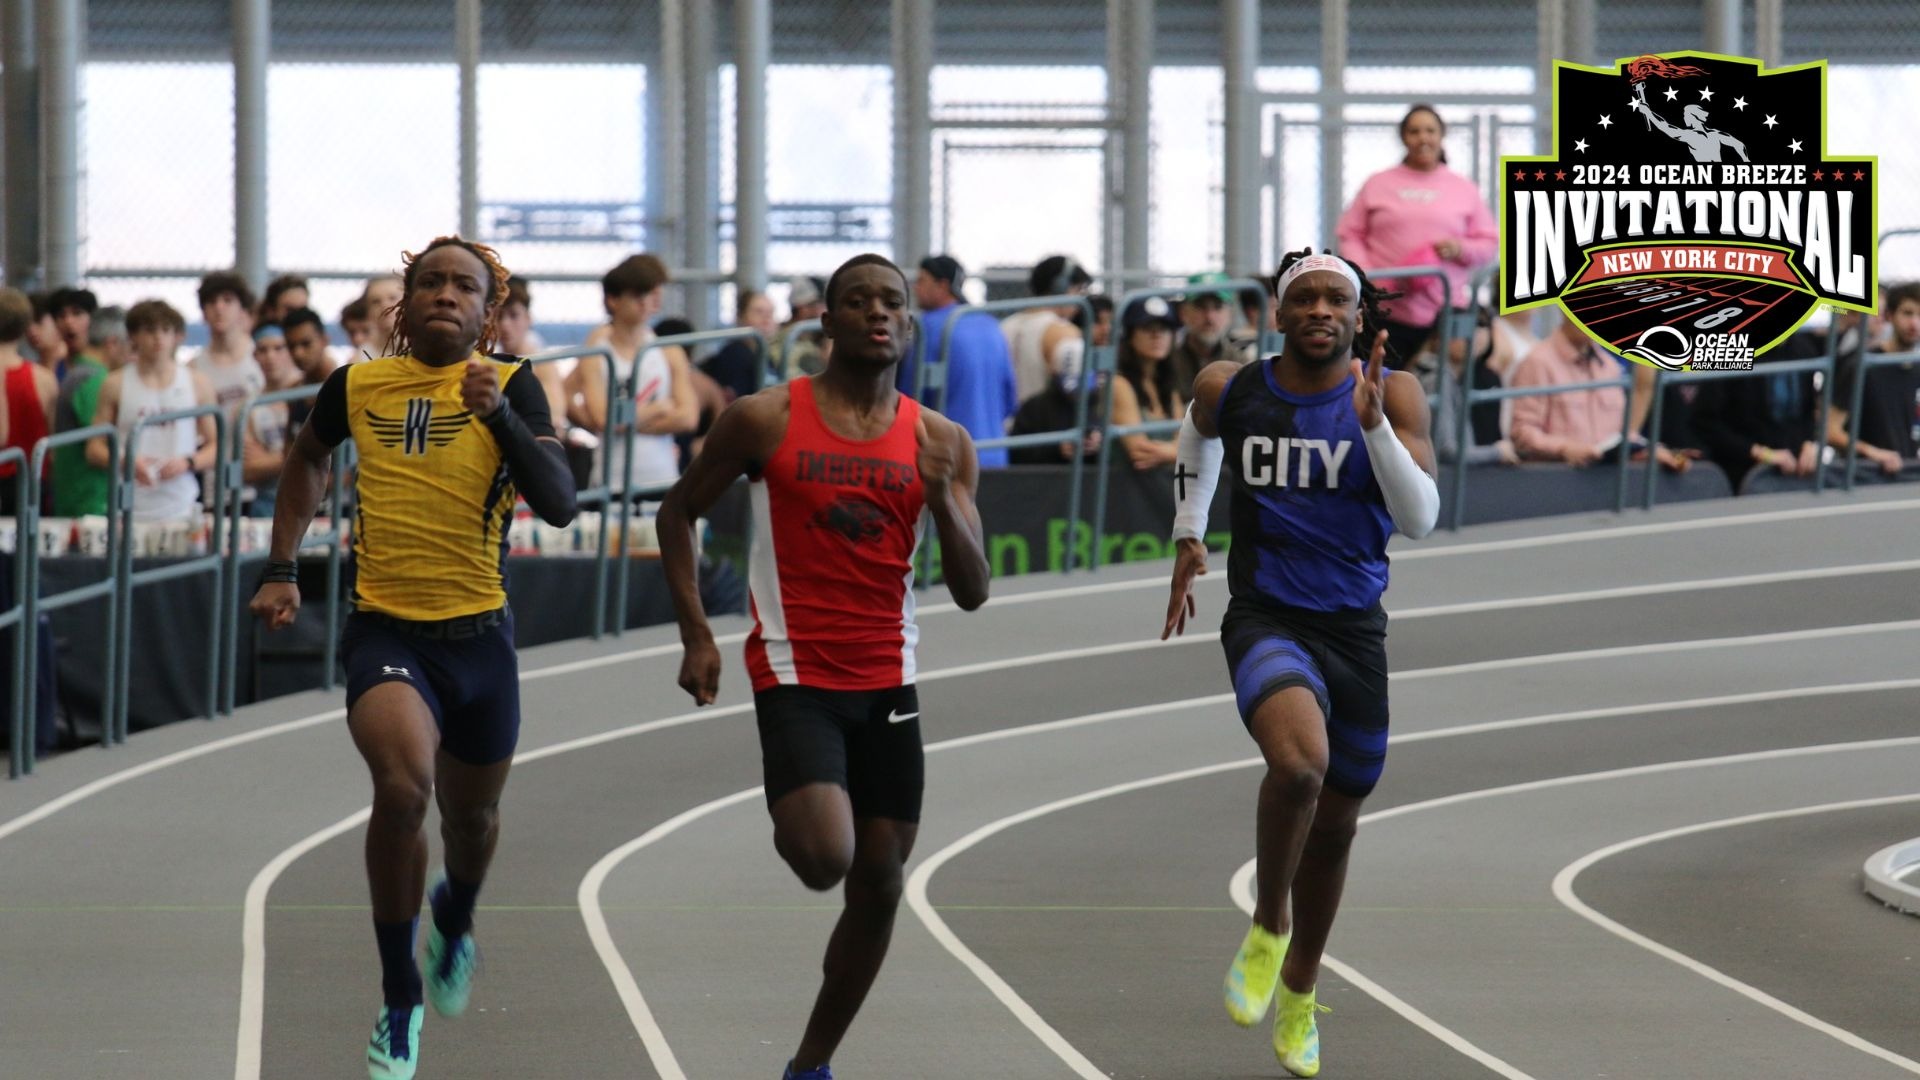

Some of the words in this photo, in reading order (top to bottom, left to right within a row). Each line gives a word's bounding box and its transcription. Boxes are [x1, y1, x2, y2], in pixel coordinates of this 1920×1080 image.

[404, 397, 434, 456] W
[795, 450, 915, 493] IMHOTEP
[1242, 435, 1352, 489] CITY
